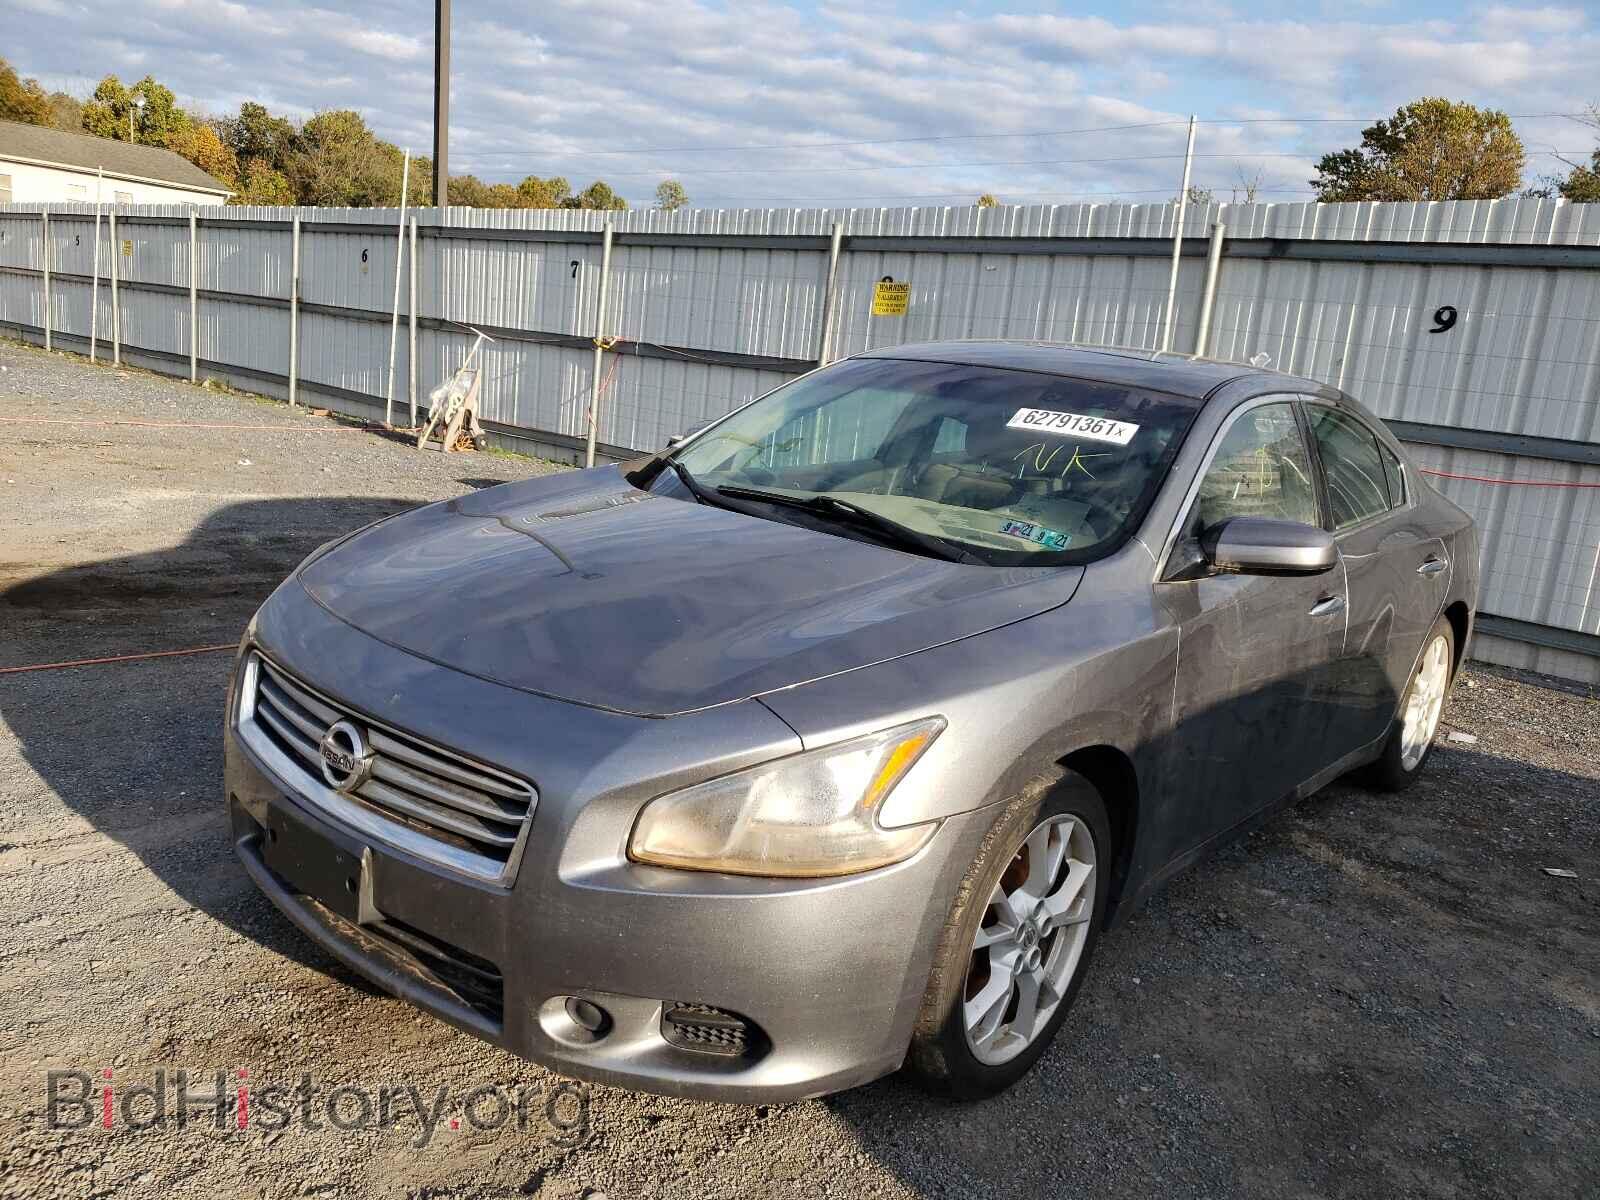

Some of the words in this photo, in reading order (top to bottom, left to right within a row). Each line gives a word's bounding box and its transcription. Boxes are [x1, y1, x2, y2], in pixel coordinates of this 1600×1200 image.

[75, 235, 80, 246] 5
[361, 248, 368, 263] 6
[570, 260, 580, 279] 7
[879, 283, 909, 291] WARNING
[1429, 306, 1457, 333] 9
[1055, 534, 1068, 547] 21
